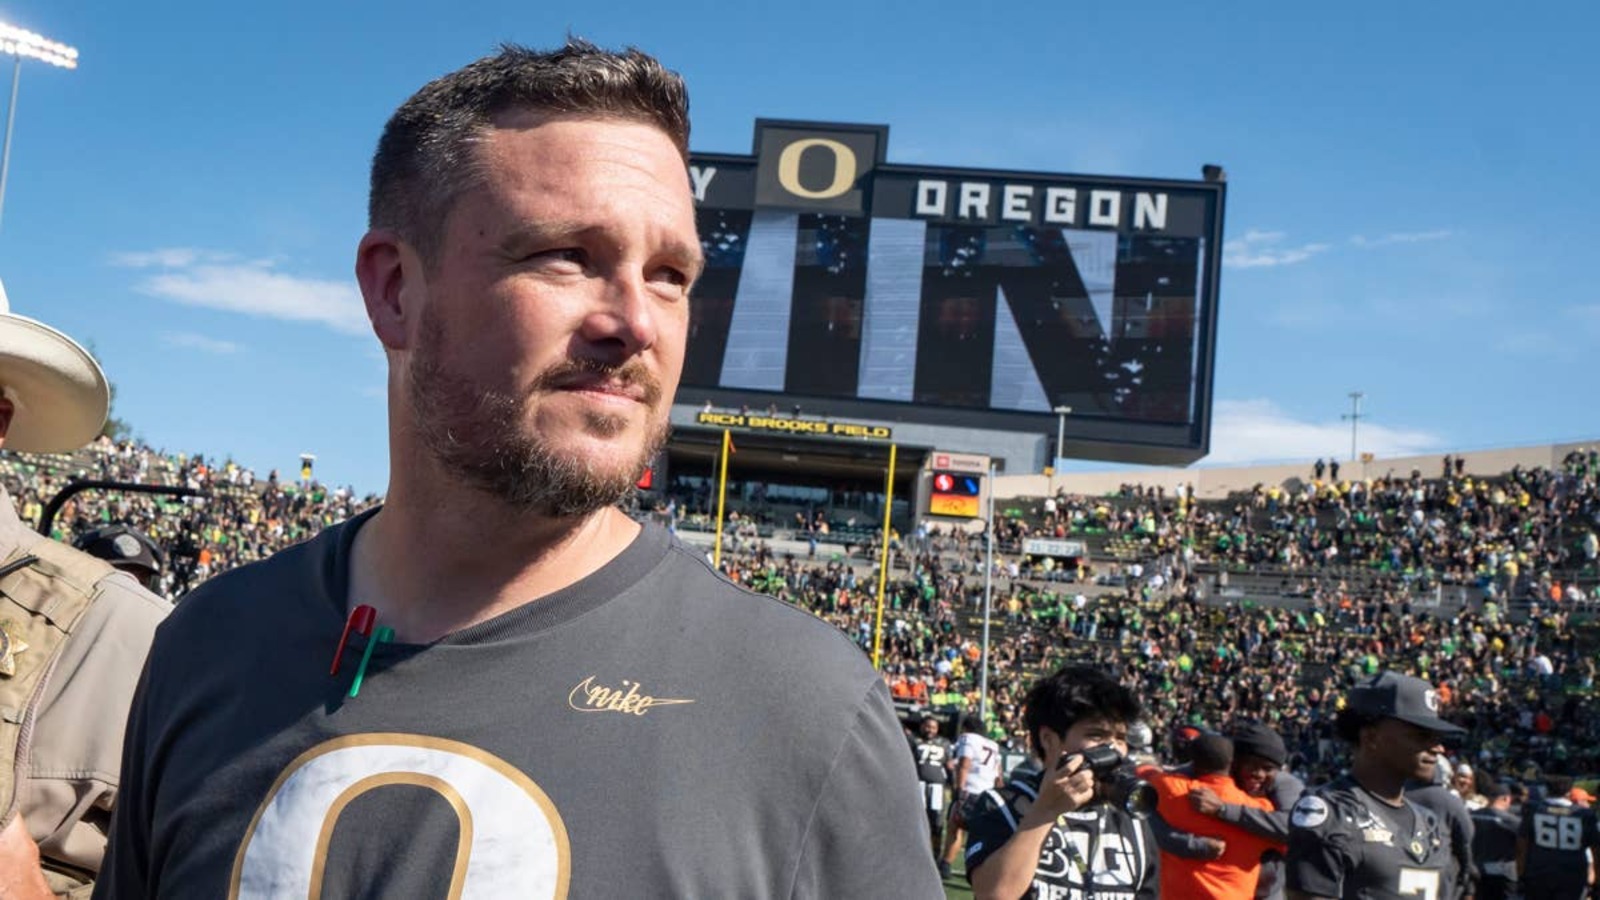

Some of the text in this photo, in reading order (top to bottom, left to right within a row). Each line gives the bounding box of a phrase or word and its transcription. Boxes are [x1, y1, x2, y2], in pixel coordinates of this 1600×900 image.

[778, 138, 857, 199] O
[916, 179, 1168, 230] OREGON
[700, 412, 890, 438] RICH BROOKS FIELD
[917, 744, 945, 767] 72
[982, 745, 994, 766] 7
[1534, 813, 1583, 851] 68
